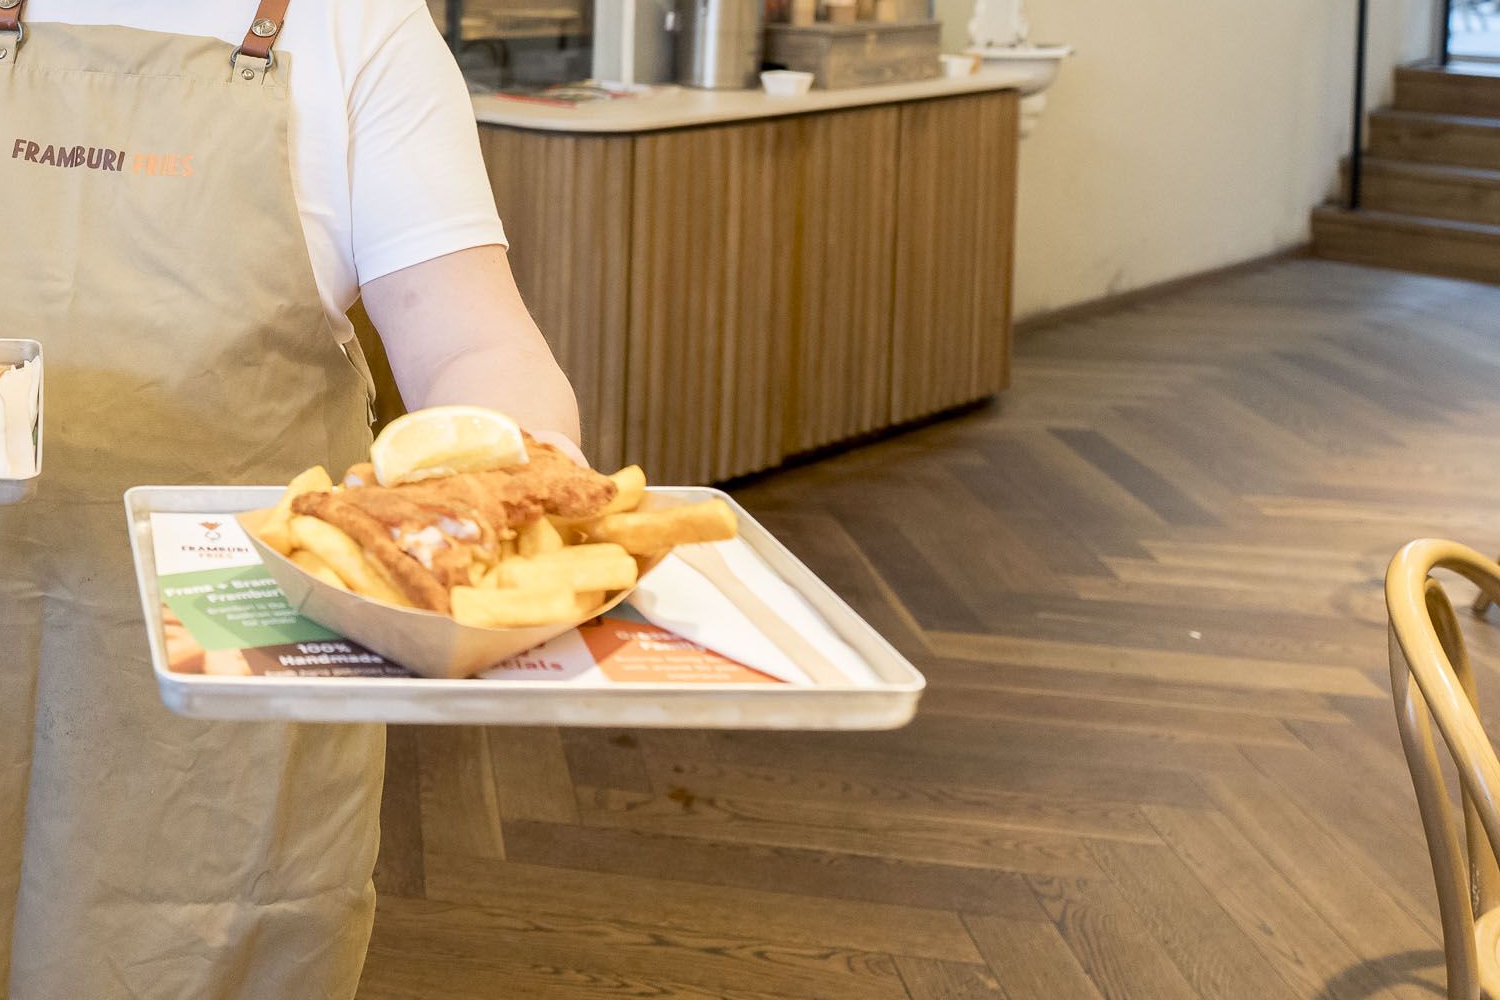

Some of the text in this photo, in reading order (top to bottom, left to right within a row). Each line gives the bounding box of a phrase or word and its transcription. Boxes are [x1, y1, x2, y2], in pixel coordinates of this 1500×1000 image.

[11, 138, 195, 177] FRAMBURI FRIES
[181, 544, 250, 553] FRAMBURI
[297, 642, 352, 655] 100%
[278, 653, 386, 667] Handmade
